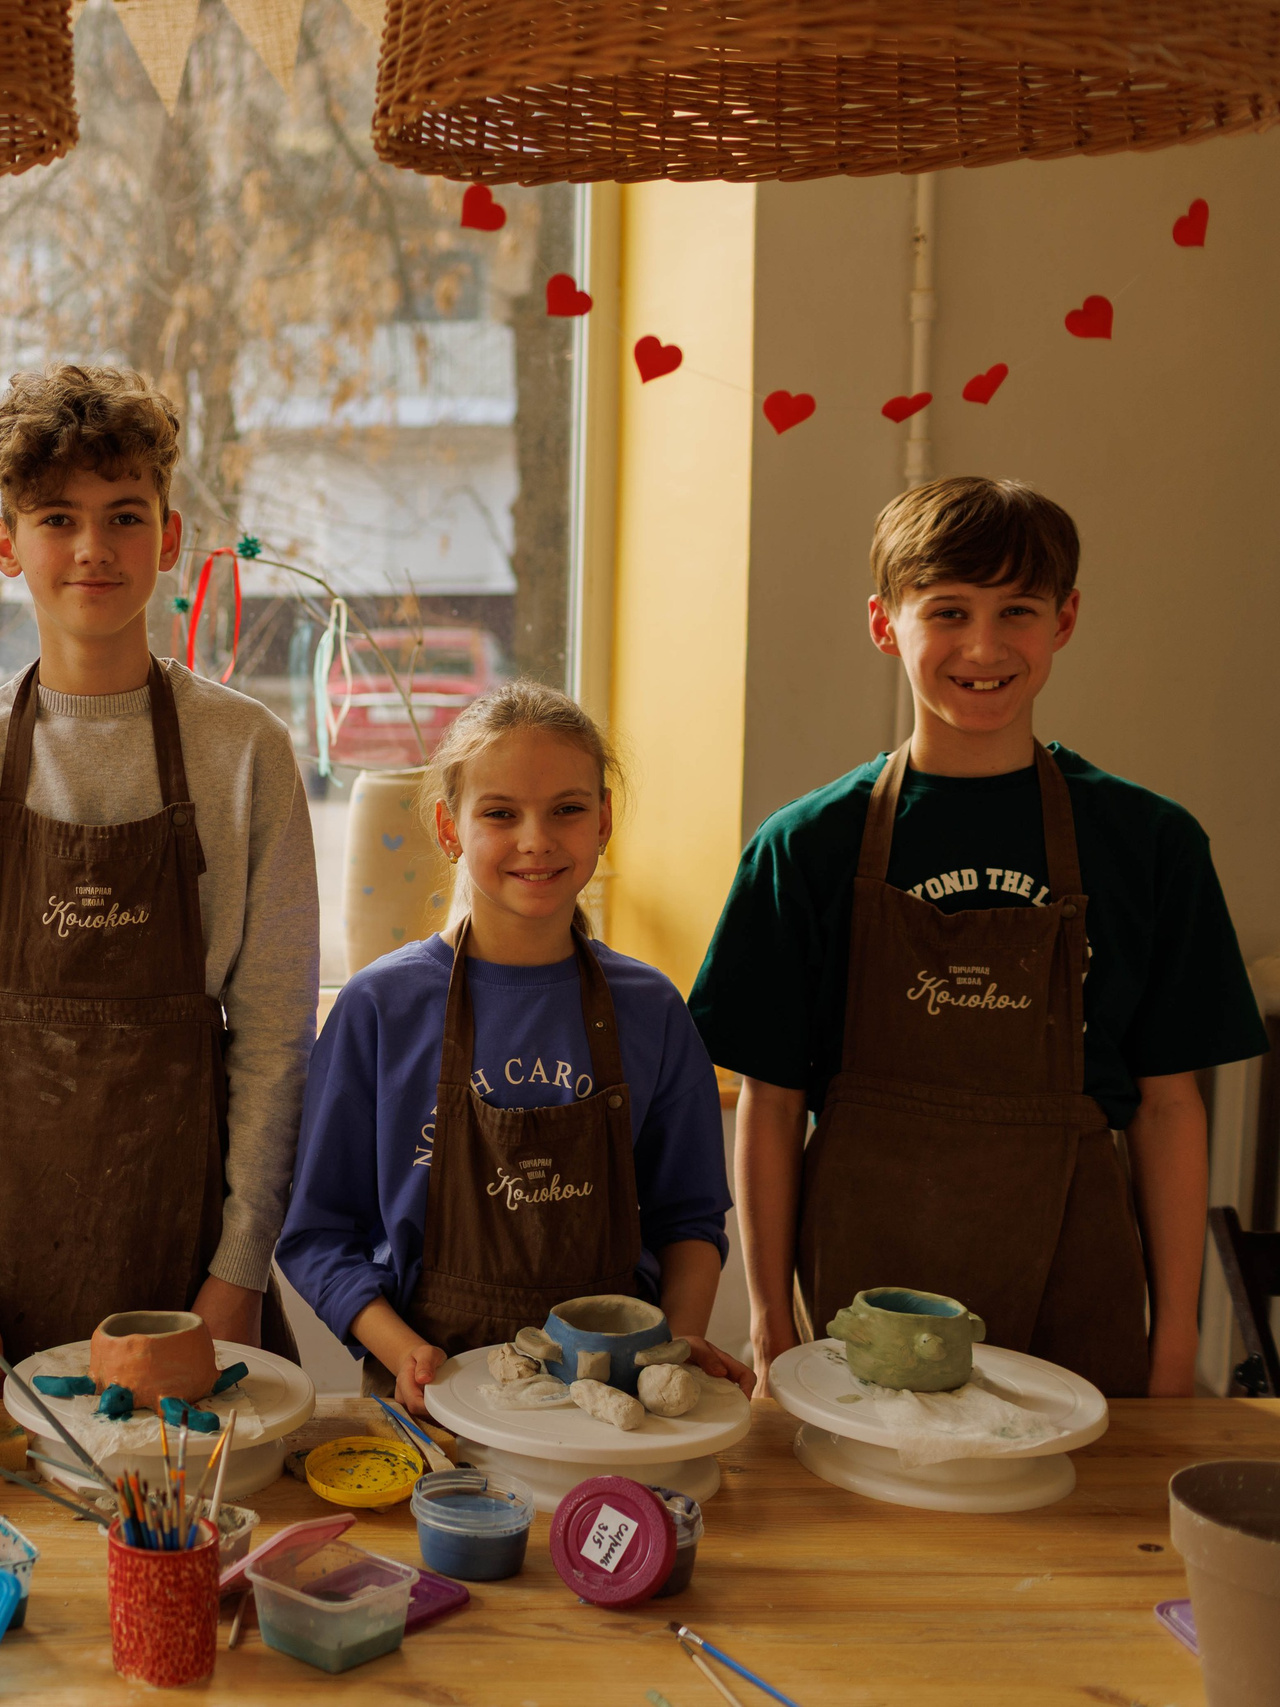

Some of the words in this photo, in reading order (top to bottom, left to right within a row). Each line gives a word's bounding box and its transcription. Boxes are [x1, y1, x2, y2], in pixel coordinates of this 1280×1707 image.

[985, 867, 1035, 898] THE
[75, 886, 113, 896] ГОНЧАРНАЯ
[81, 898, 105, 907] ШКОЛА
[948, 965, 990, 975] ГОНЧАРНАЯ
[956, 977, 982, 986] ШКОЛА
[592, 1522, 609, 1550] 315
